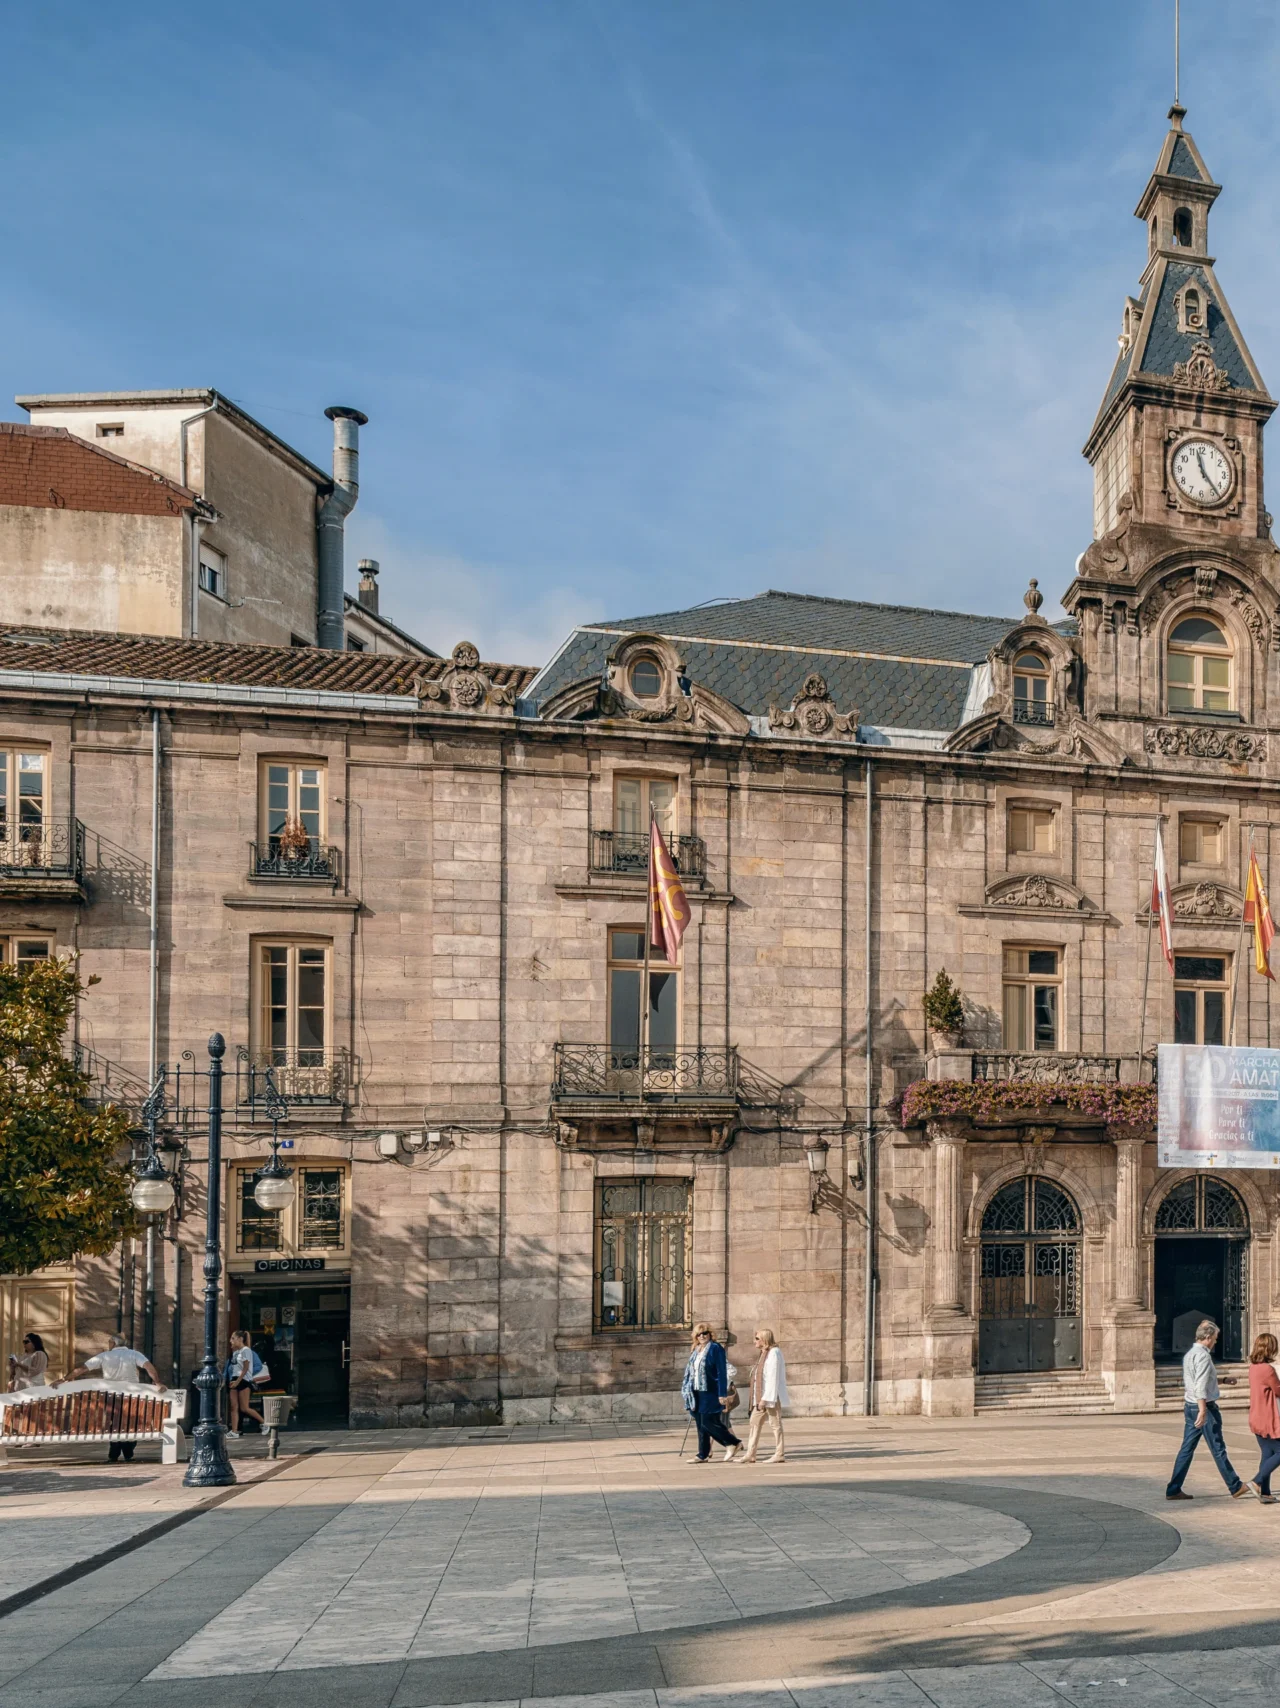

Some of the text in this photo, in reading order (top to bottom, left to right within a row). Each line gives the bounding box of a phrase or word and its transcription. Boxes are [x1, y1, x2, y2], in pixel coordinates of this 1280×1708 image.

[1189, 448, 1195, 456] 11
[1198, 447, 1206, 455] 12
[1210, 451, 1214, 459] 1
[1181, 455, 1188, 463] 10
[1217, 459, 1222, 467] 2
[1177, 465, 1182, 473] 9
[1221, 471, 1226, 479] 3
[1199, 490, 1204, 498] 6
[1229, 1056, 1279, 1068] MARCHA
[1184, 1054, 1226, 1085] 30
[1229, 1069, 1279, 1086] AMAT
[1221, 1104, 1243, 1115] Por ti
[1218, 1116, 1245, 1129] Para ti
[1208, 1129, 1238, 1141] Gracias
[1247, 1130, 1255, 1142] ti
[258, 1259, 321, 1271] OFICINAS
